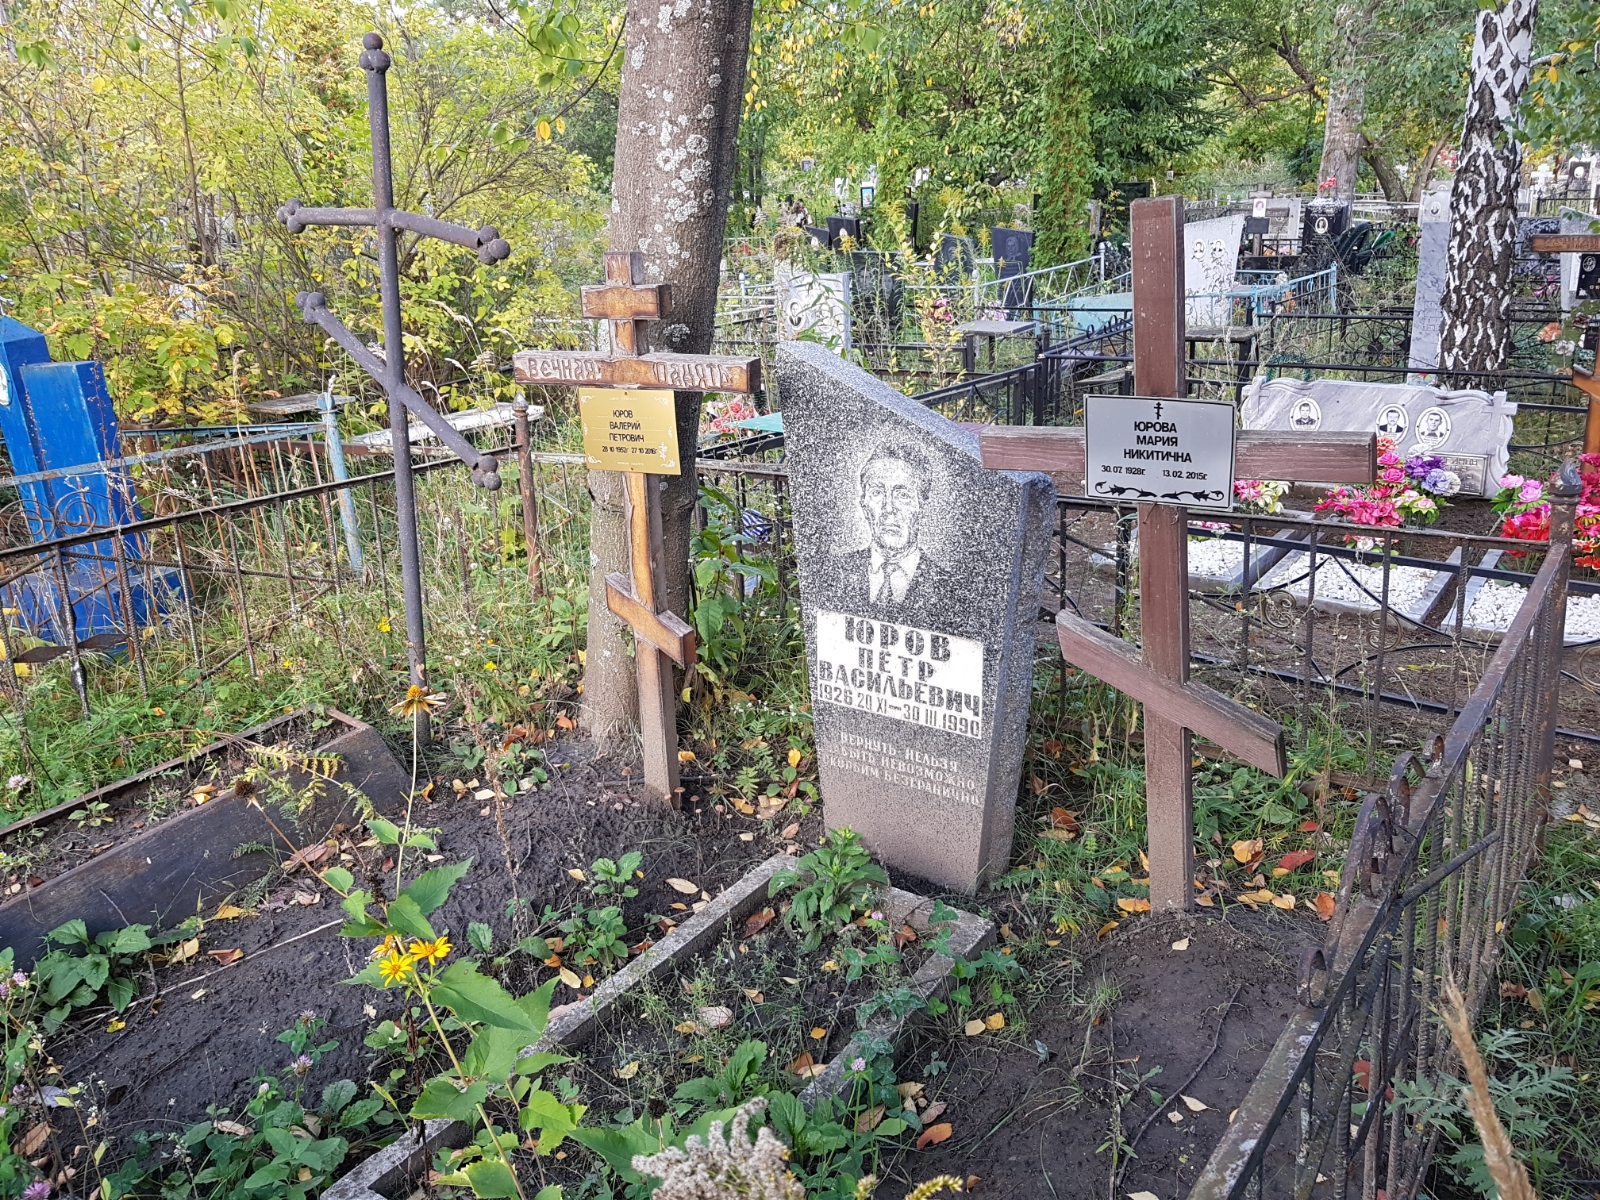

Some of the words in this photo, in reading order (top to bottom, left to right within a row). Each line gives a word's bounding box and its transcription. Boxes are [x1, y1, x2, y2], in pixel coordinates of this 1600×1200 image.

[612, 409, 633, 418] ЮРОВ
[609, 420, 641, 430] ВАЛЕРИЙ
[1134, 421, 1177, 433] ЮРОВА
[609, 433, 644, 442] ПЕТРОВИЧ
[1136, 435, 1178, 447] МАРИЯ
[1123, 448, 1192, 463] НИКИТИЧНА
[845, 615, 951, 662] ЮРОВ
[858, 647, 935, 681] ПЕТР
[818, 660, 980, 717] ВАСИЛЬЕВИЧ
[840, 732, 896, 756] ВЕРНУТЬ
[905, 748, 958, 773] НЕЛЬЗЯ
